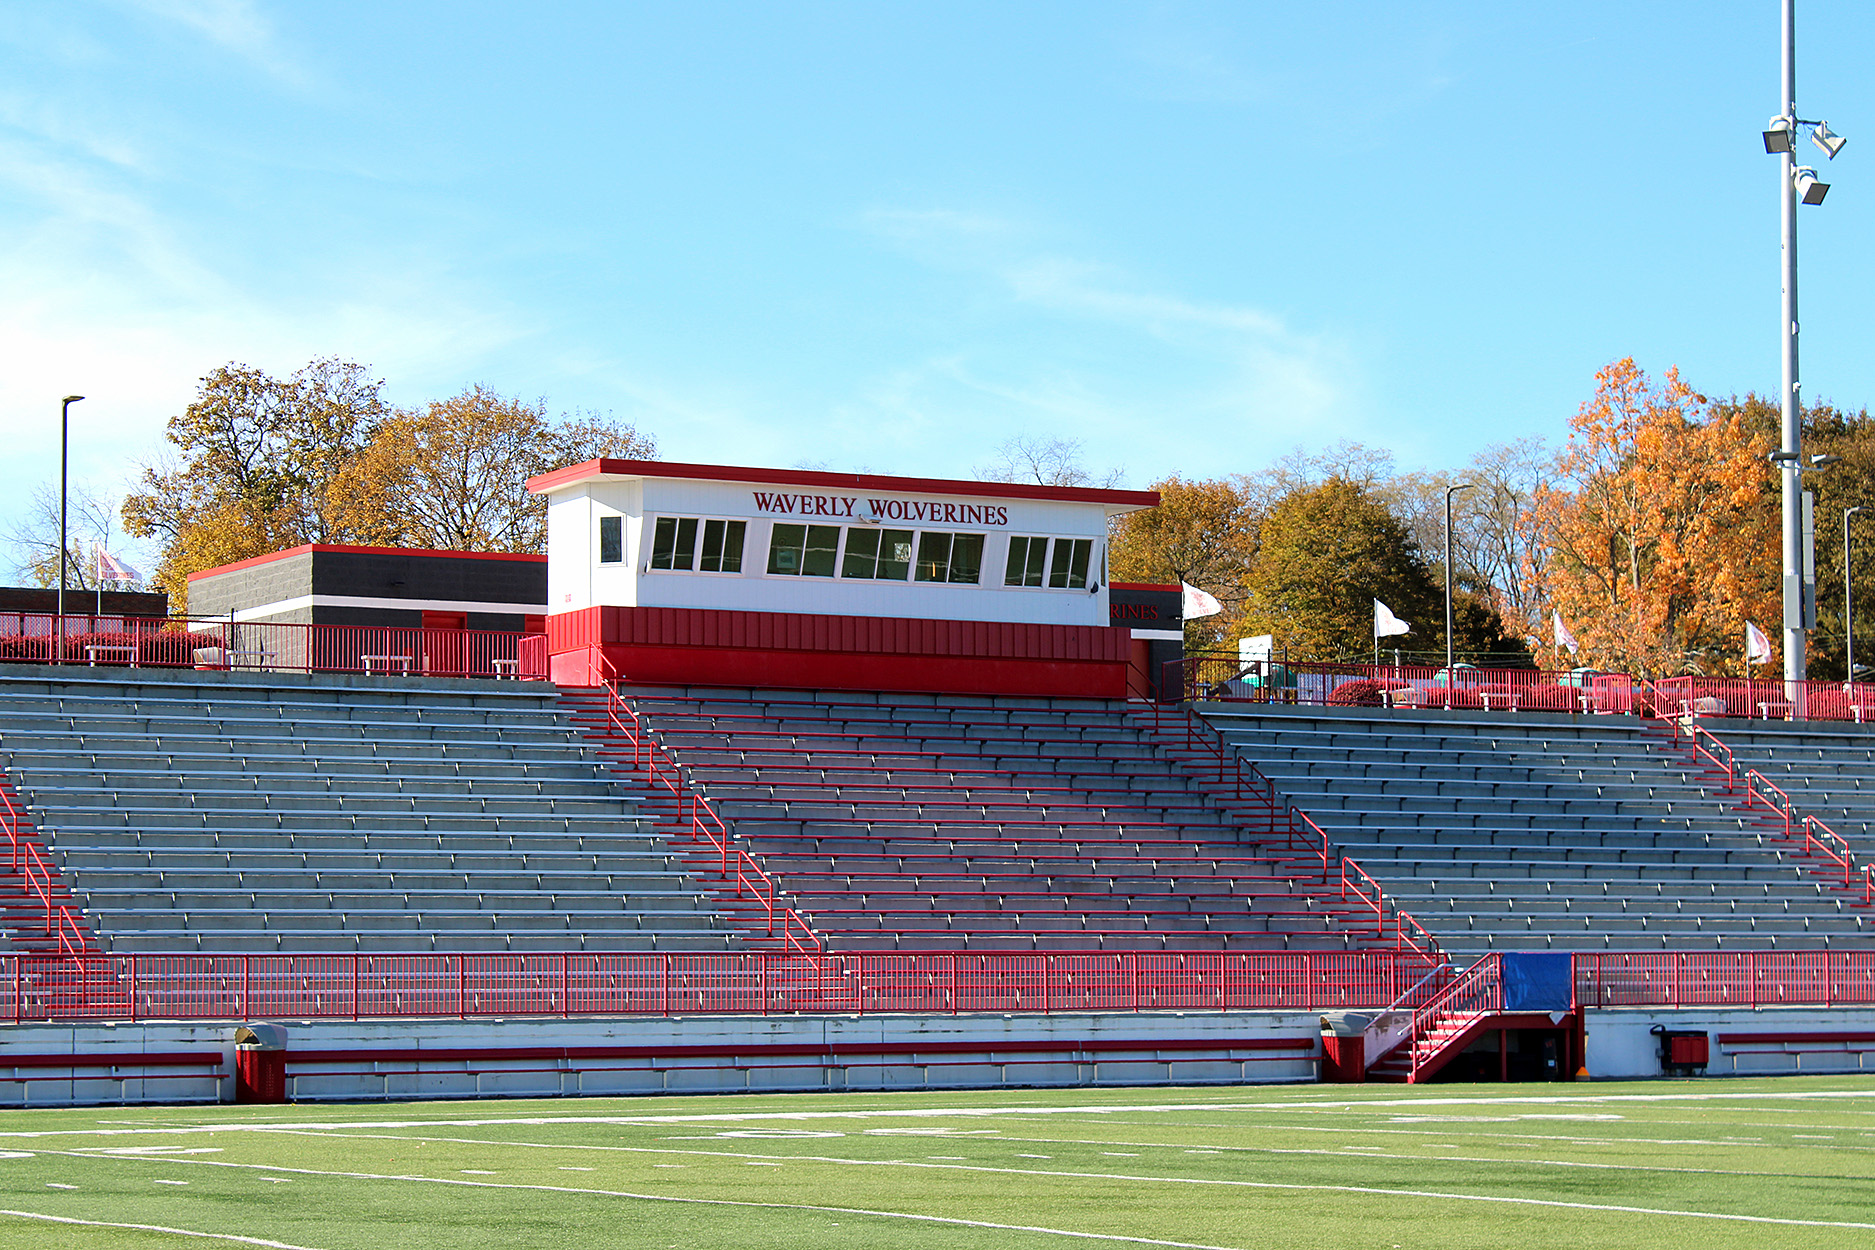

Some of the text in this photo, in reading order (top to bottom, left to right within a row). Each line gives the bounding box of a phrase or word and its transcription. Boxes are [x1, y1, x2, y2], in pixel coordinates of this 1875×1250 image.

[753, 492, 1008, 525] WAVERLY WOLVERINES
[1110, 604, 1159, 620] RINES
